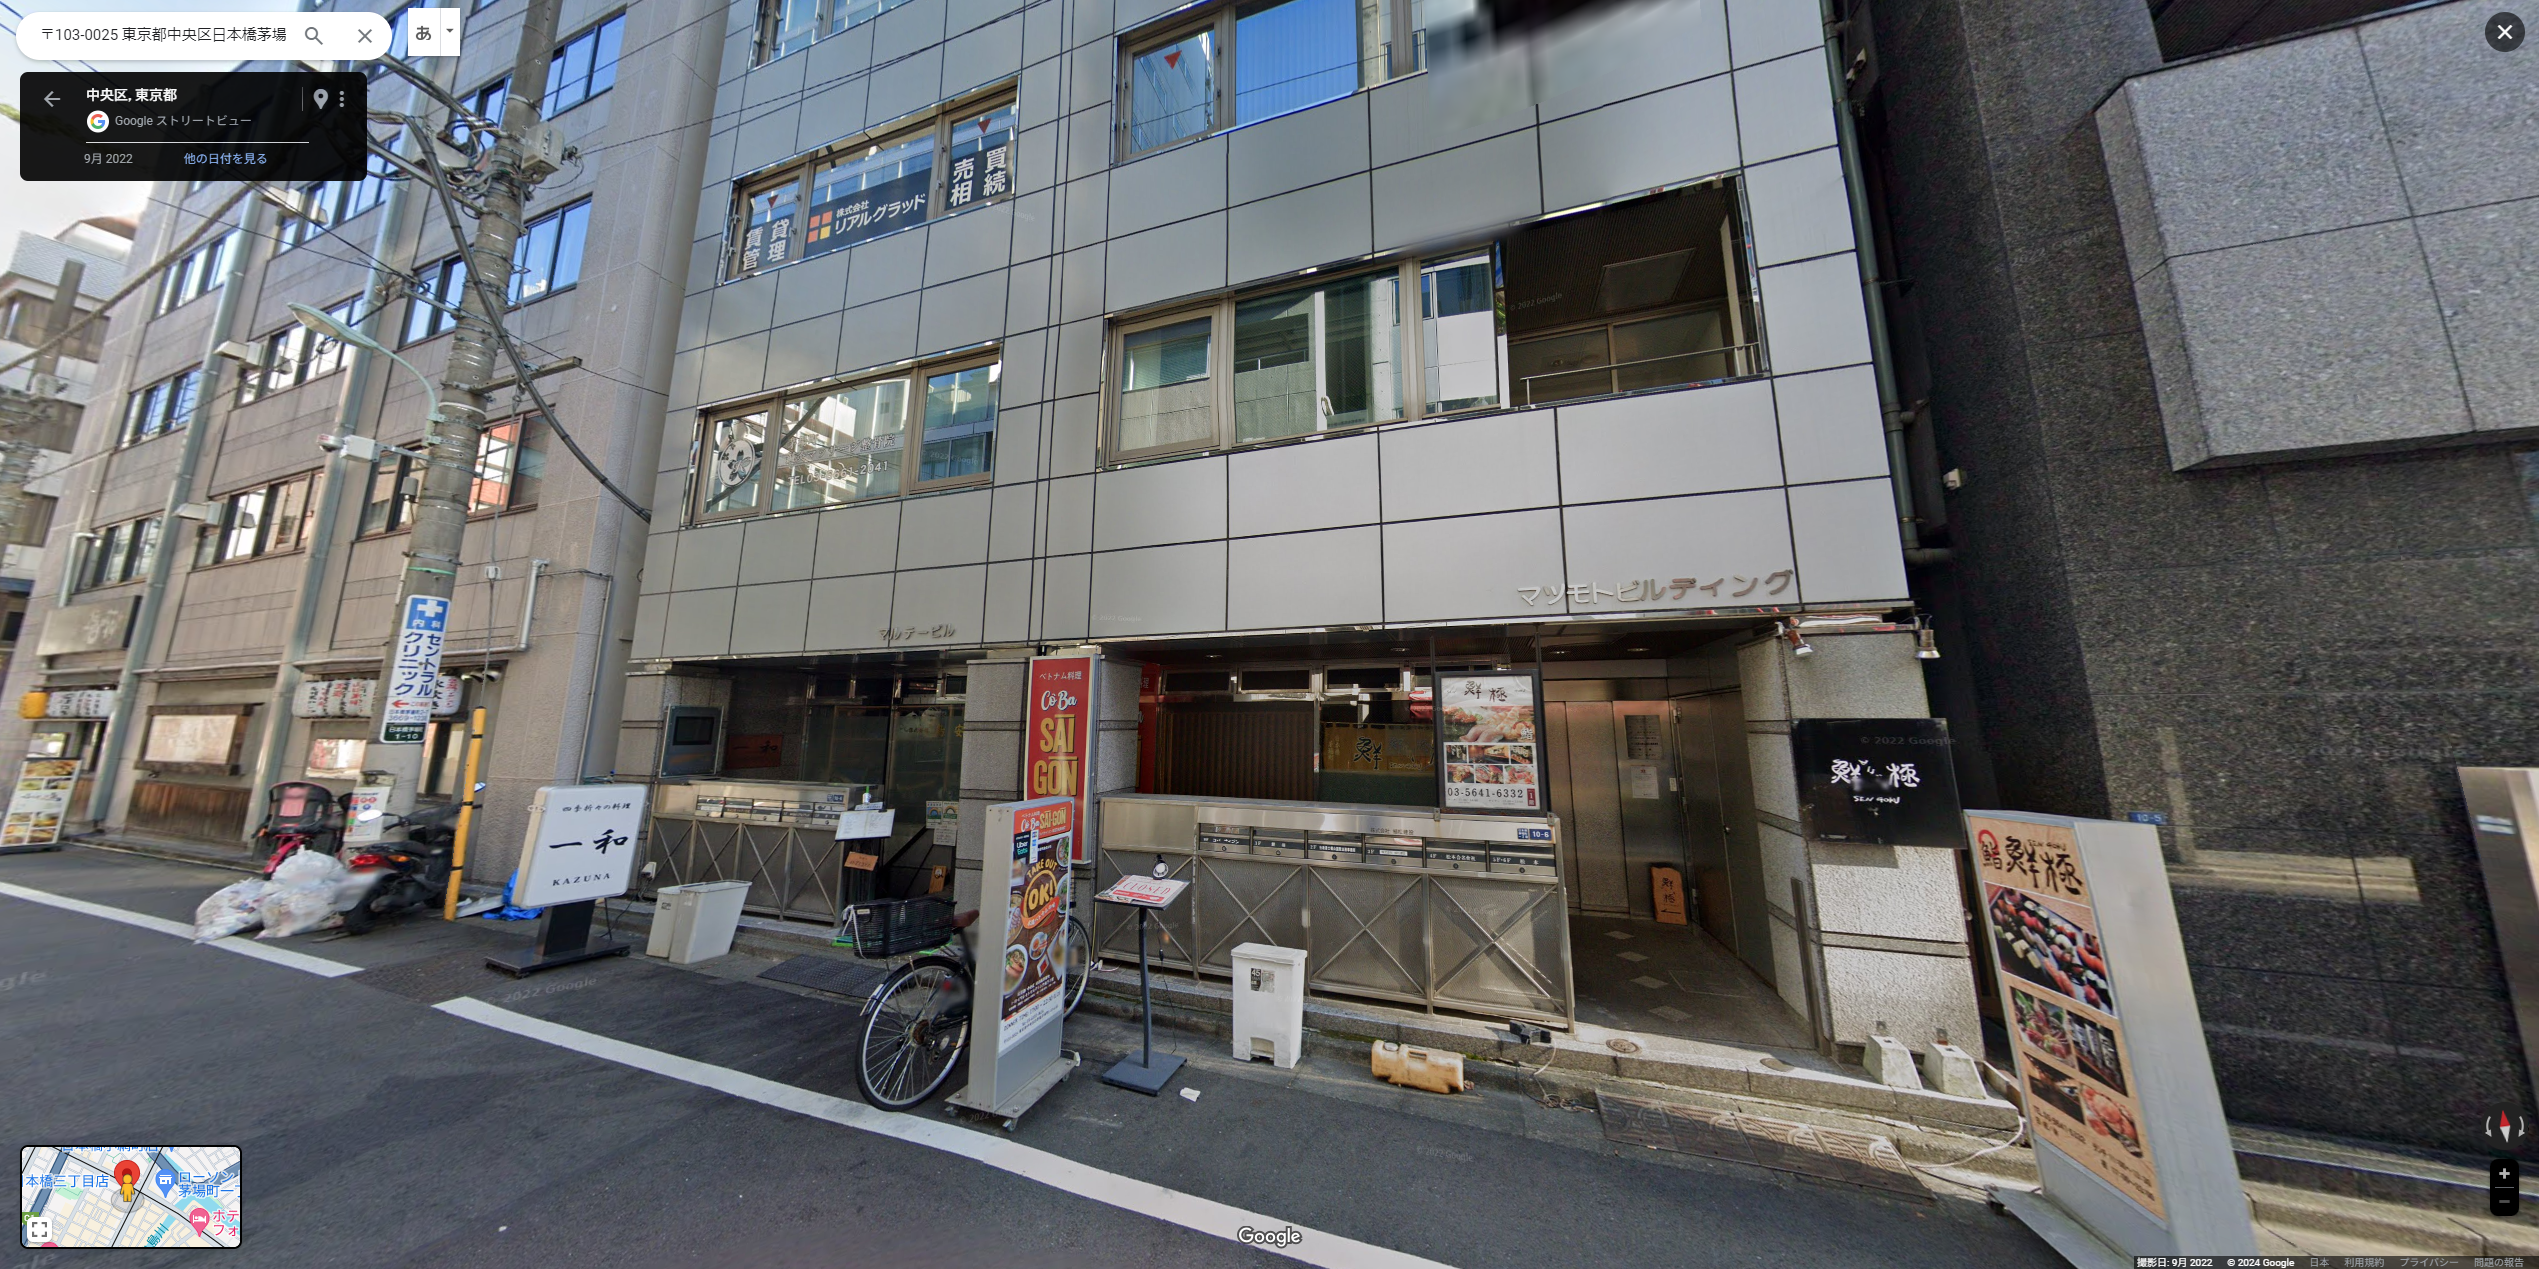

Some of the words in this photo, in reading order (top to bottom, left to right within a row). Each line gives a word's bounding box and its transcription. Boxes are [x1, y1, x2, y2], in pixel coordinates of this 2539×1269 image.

[835, 194, 927, 235] リアルグラッド
[836, 200, 869, 218] 株式会社
[1517, 569, 1794, 607] マツモトビルディング
[878, 623, 956, 640] マルテービル
[394, 631, 424, 696] クリニック
[416, 633, 442, 697] セントラル
[1039, 670, 1083, 681] ベトナム料理
[1057, 690, 1077, 711] Ba
[1447, 787, 1524, 799] 03-5641-6332
[562, 802, 632, 813] 四季折々の料理
[549, 828, 629, 855] 一和
[1532, 830, 1550, 838] 10-6
[1016, 841, 1028, 849] Uber
[1026, 858, 1045, 879] TAKE
[1044, 858, 1059, 871] OUT
[552, 872, 611, 887] KAZUNA
[1027, 879, 1055, 911] OK!
[1122, 881, 1172, 896] CLOSED
[1251, 969, 1261, 977] 45
